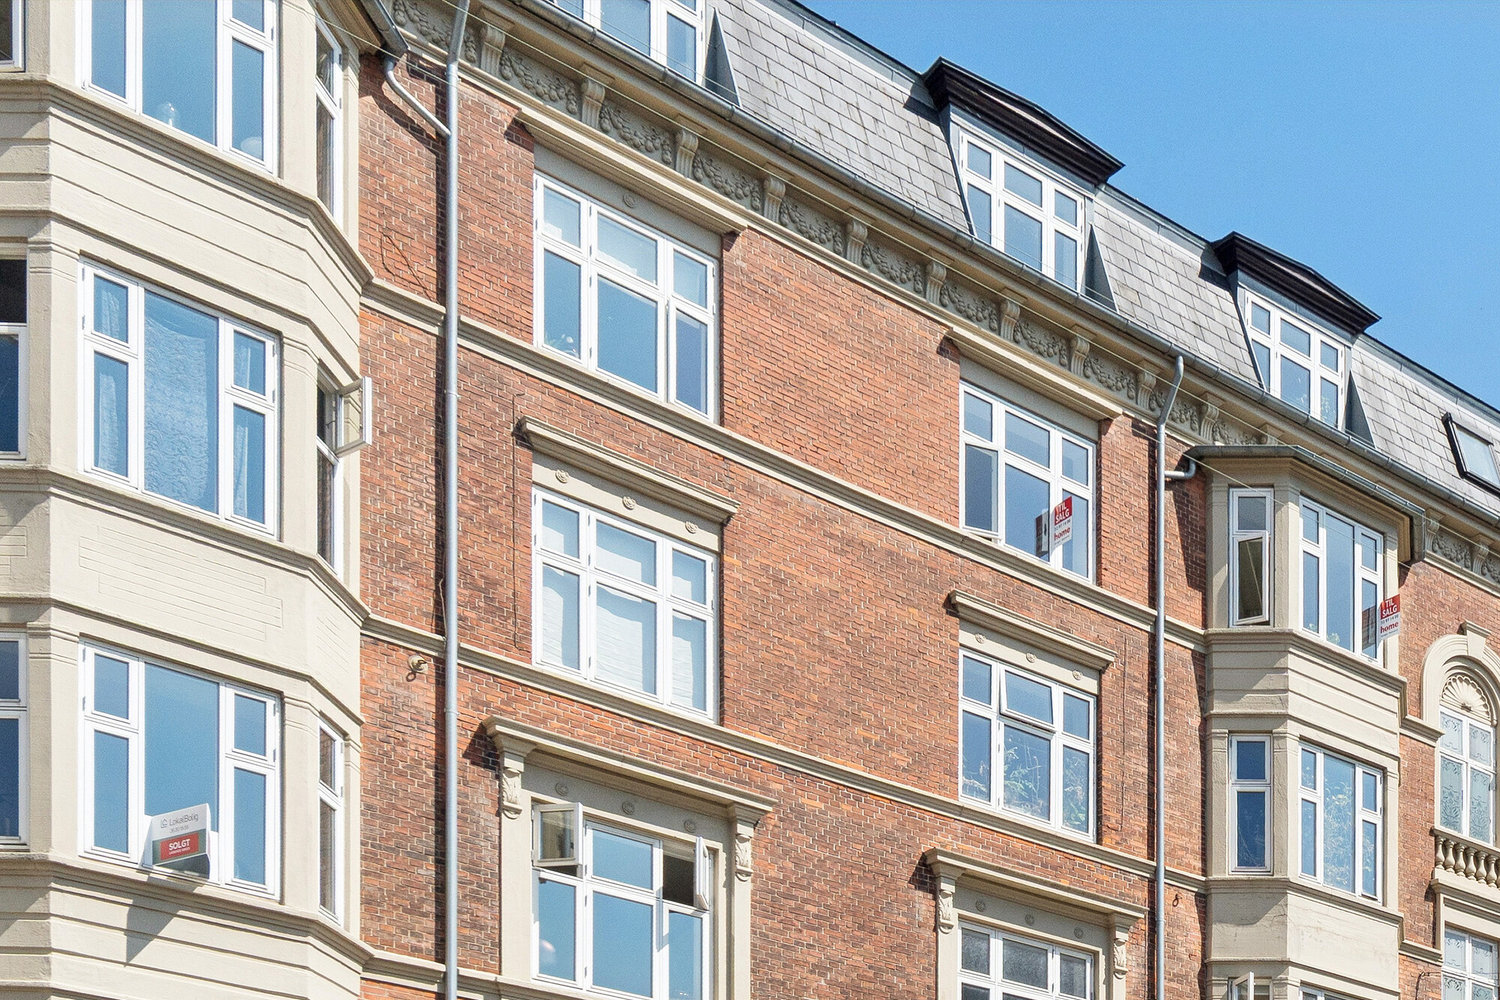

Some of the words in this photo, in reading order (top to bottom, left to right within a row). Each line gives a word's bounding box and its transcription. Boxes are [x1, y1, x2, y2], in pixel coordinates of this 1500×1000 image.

[1055, 508, 1070, 524] SALG
[1054, 527, 1071, 541] home
[1382, 605, 1398, 617] SALG
[1380, 621, 1399, 634] home
[168, 838, 191, 851] SOLGT
